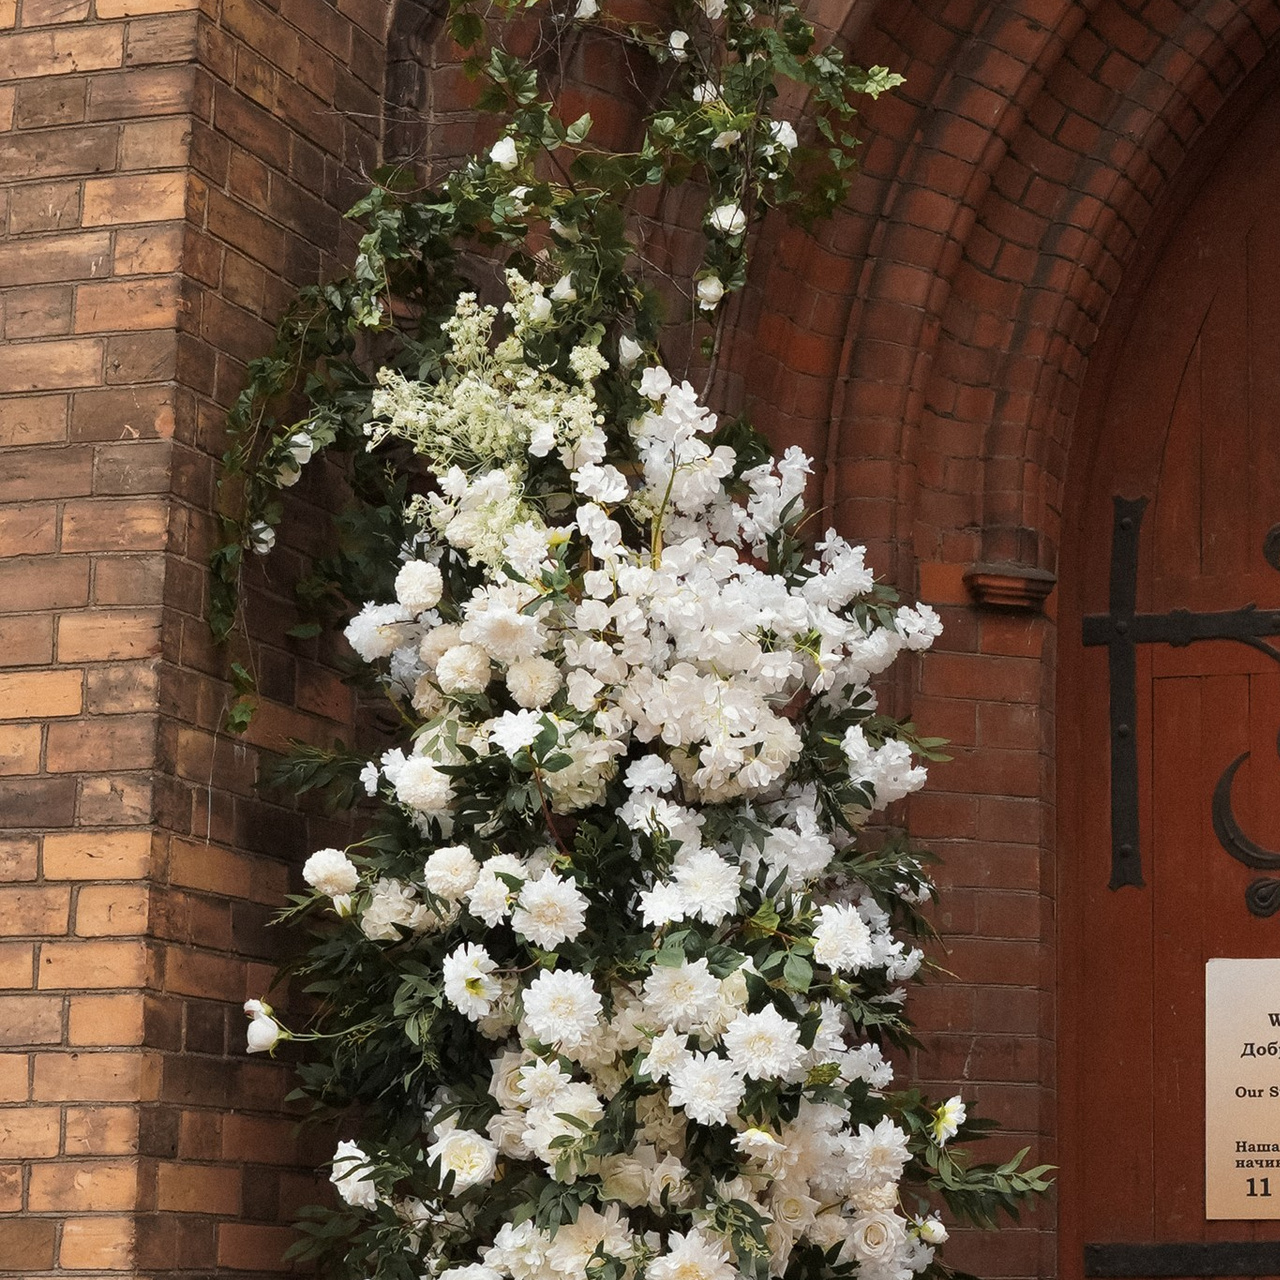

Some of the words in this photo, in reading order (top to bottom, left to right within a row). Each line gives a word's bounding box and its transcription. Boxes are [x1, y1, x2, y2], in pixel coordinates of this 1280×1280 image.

[1235, 1086, 1264, 1098] Our
[1236, 1141, 1280, 1152] Наша
[1246, 1178, 1272, 1196] 11
